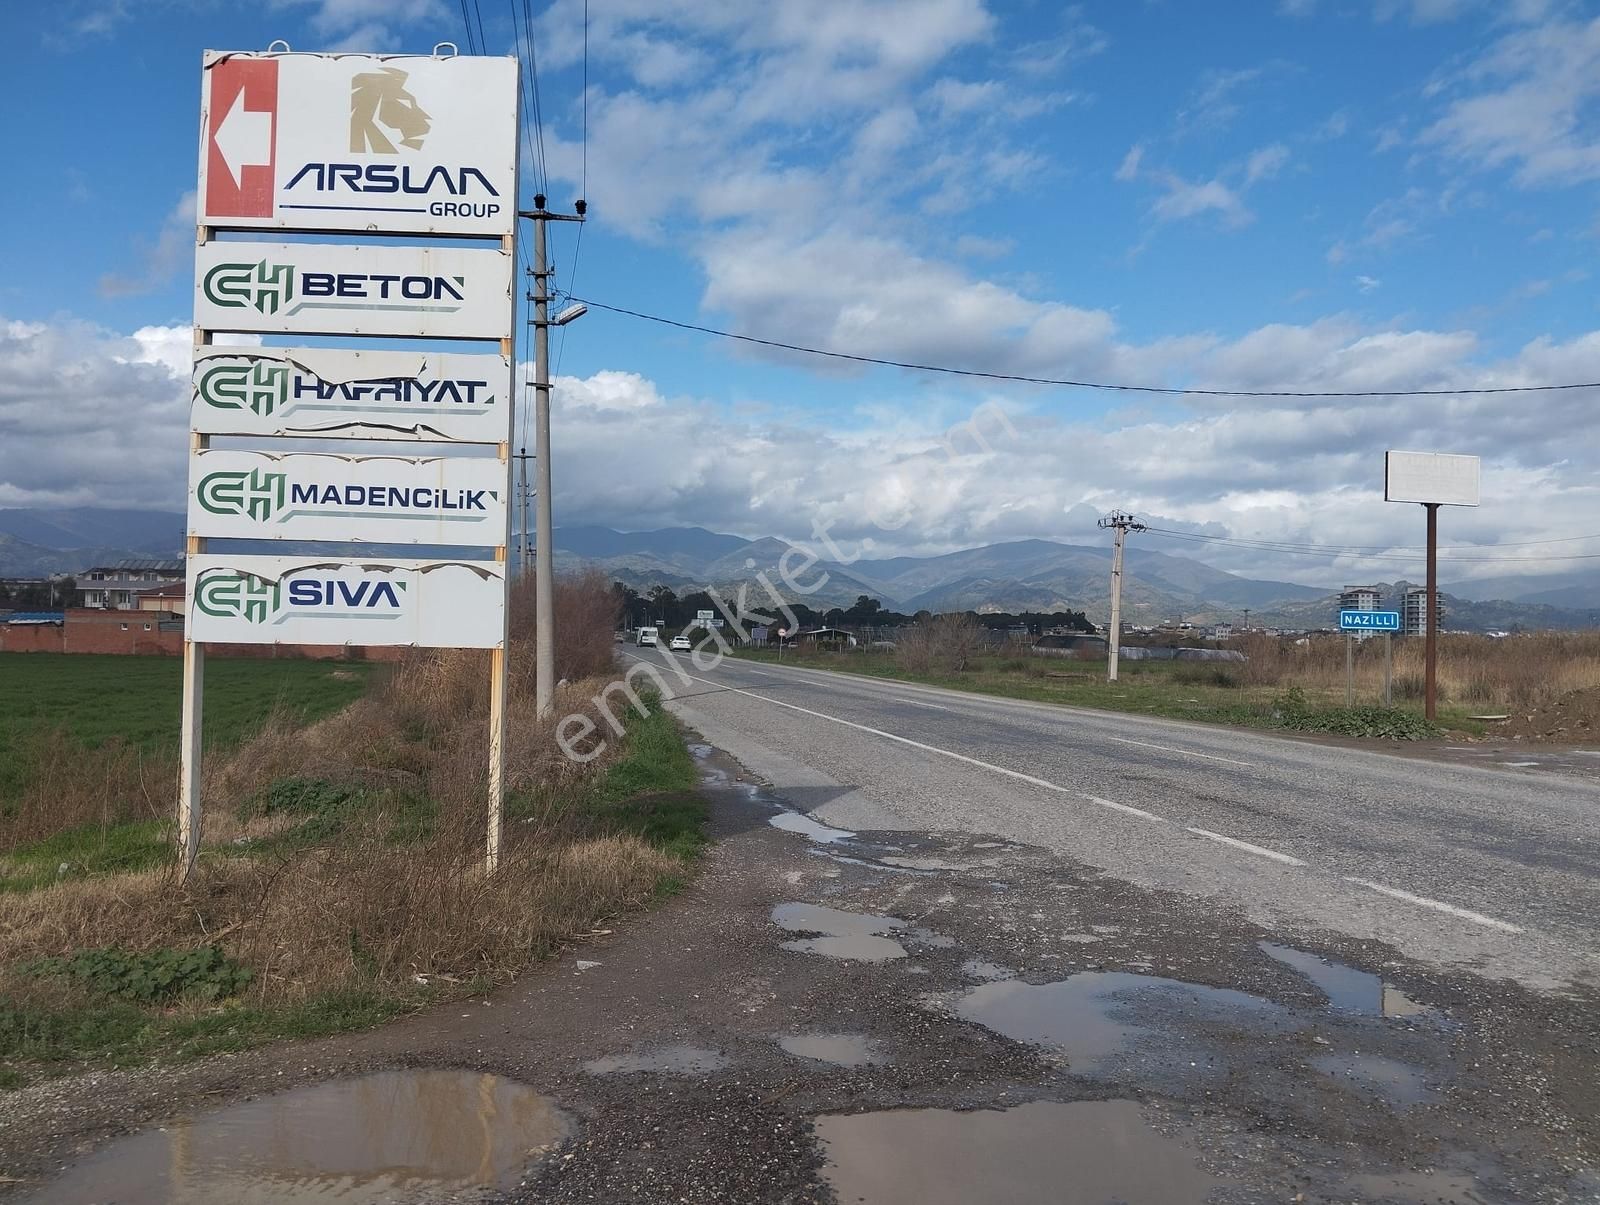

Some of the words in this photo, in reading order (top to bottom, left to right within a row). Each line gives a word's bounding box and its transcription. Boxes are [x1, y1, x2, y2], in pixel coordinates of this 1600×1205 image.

[283, 163, 500, 197] ARSLAN
[429, 202, 500, 218] GROUP
[301, 272, 464, 300] BETON
[288, 579, 401, 608] SIVA
